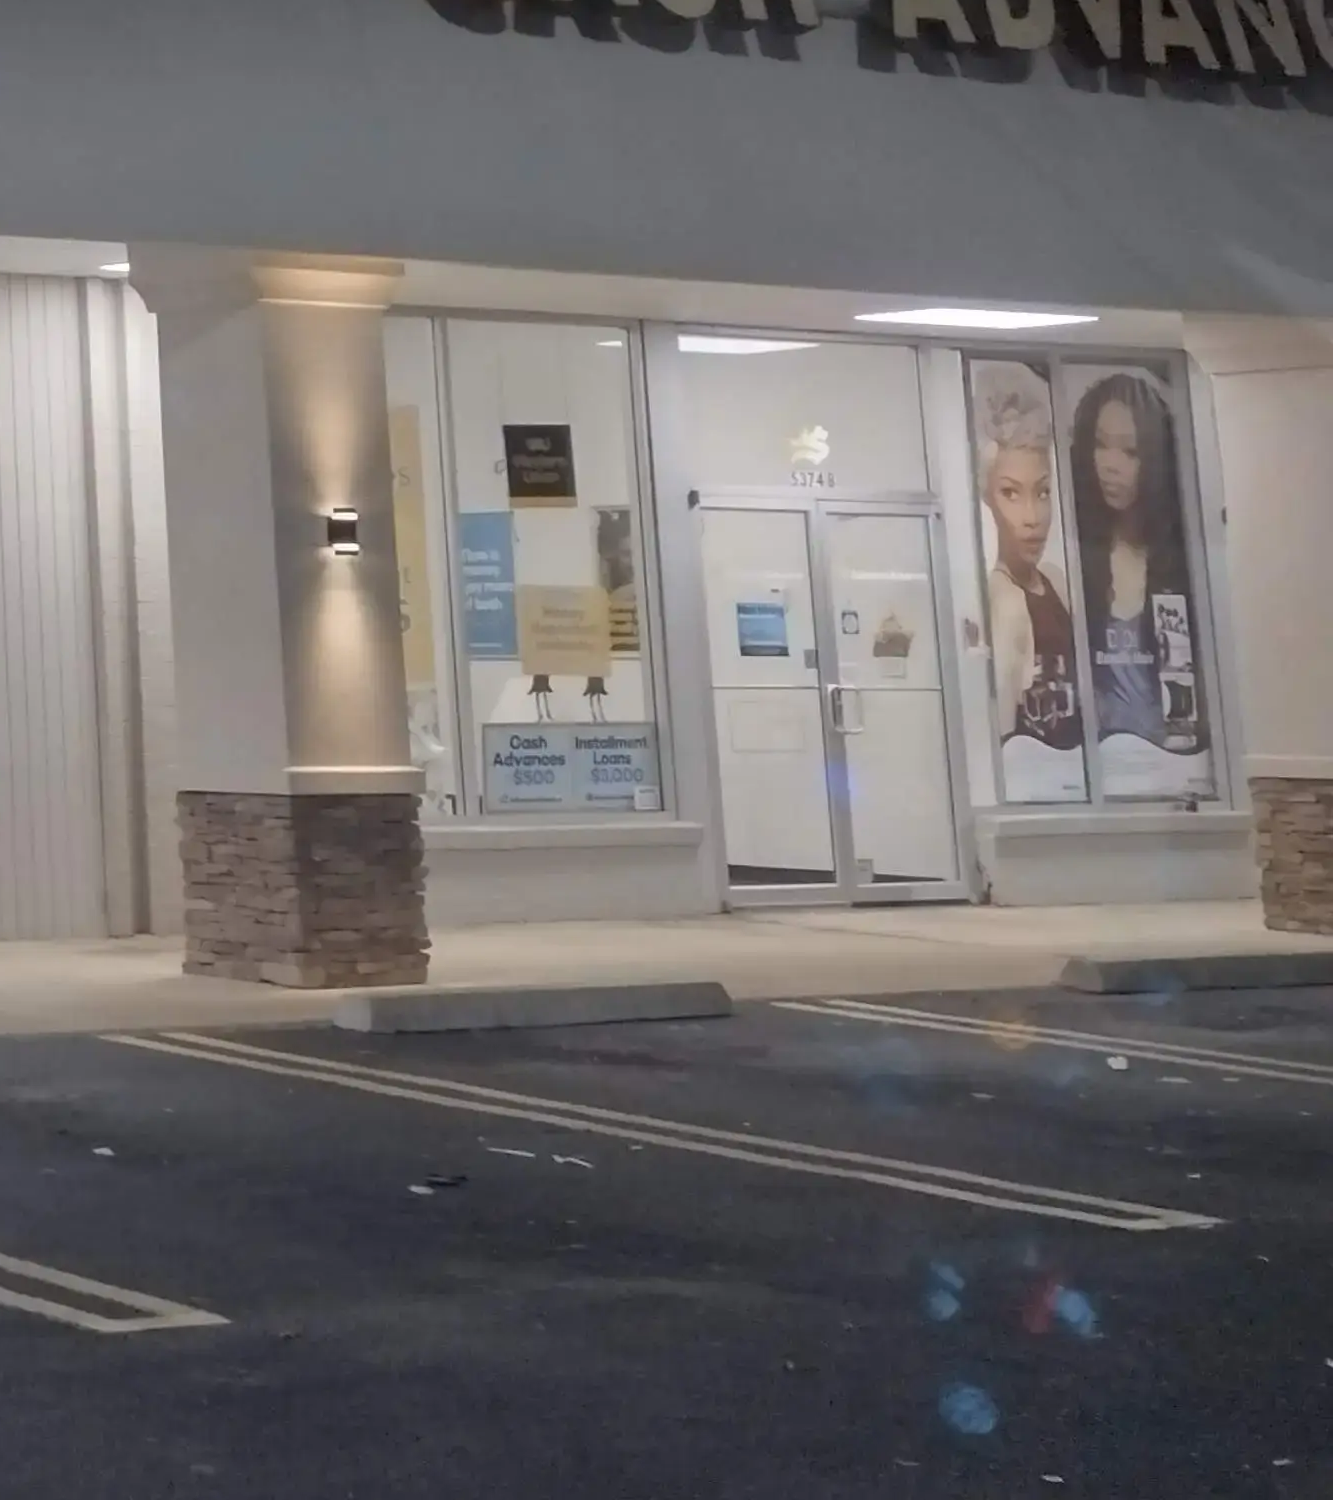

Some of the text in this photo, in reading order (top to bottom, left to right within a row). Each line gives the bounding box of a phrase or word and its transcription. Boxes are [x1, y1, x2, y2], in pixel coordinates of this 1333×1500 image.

[790, 471, 824, 488] 5374
[509, 734, 548, 750] Cash
[574, 735, 649, 750] Installment
[493, 752, 566, 767] Advances
[593, 752, 632, 766] Loans
[513, 768, 556, 786] $500
